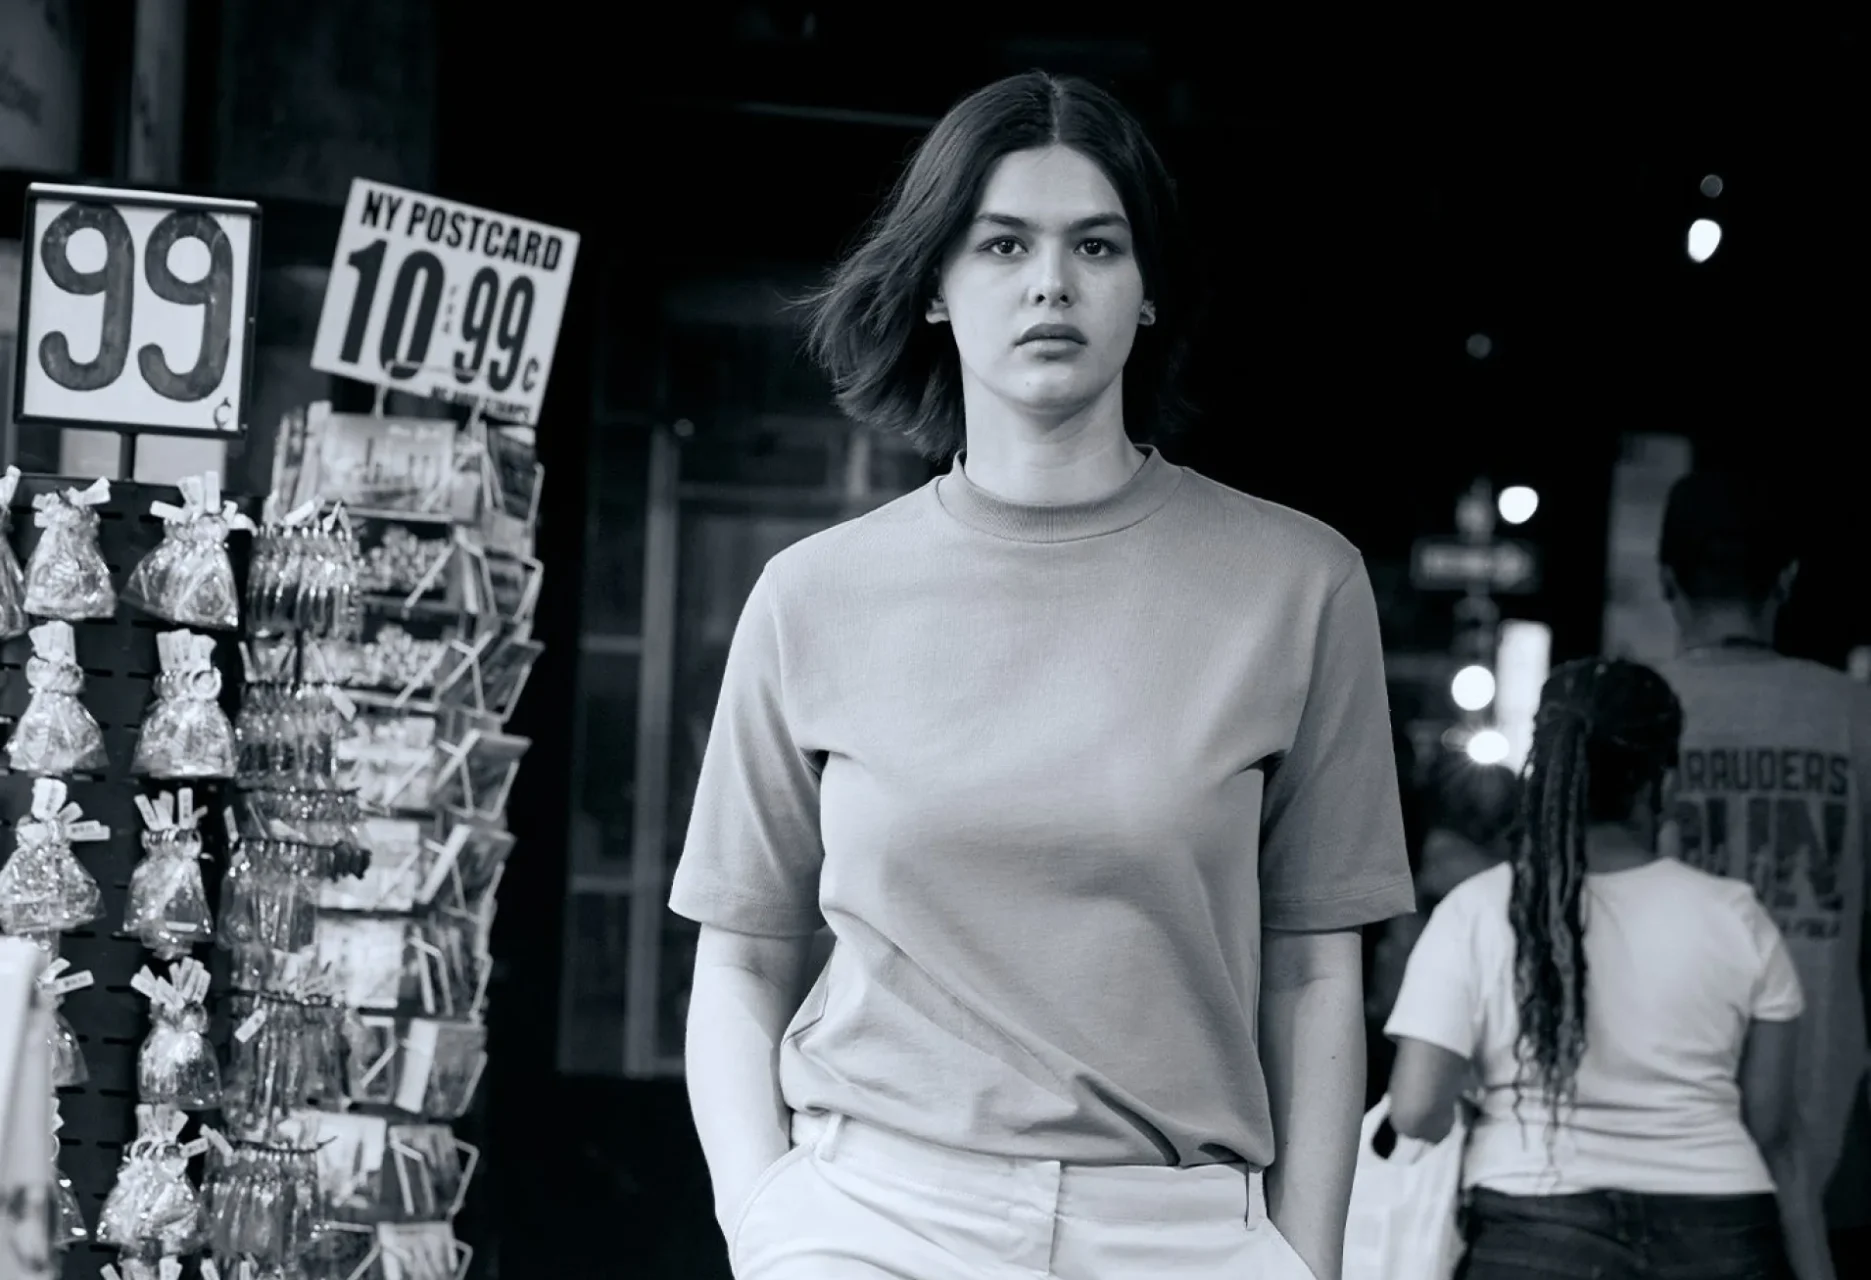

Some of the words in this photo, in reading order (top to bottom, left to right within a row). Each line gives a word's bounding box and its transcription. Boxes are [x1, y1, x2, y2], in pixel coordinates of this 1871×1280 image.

[361, 190, 403, 232] NY
[407, 200, 563, 272] POSTCARD
[340, 238, 445, 380] 10
[1686, 749, 1850, 796] RAUDERS
